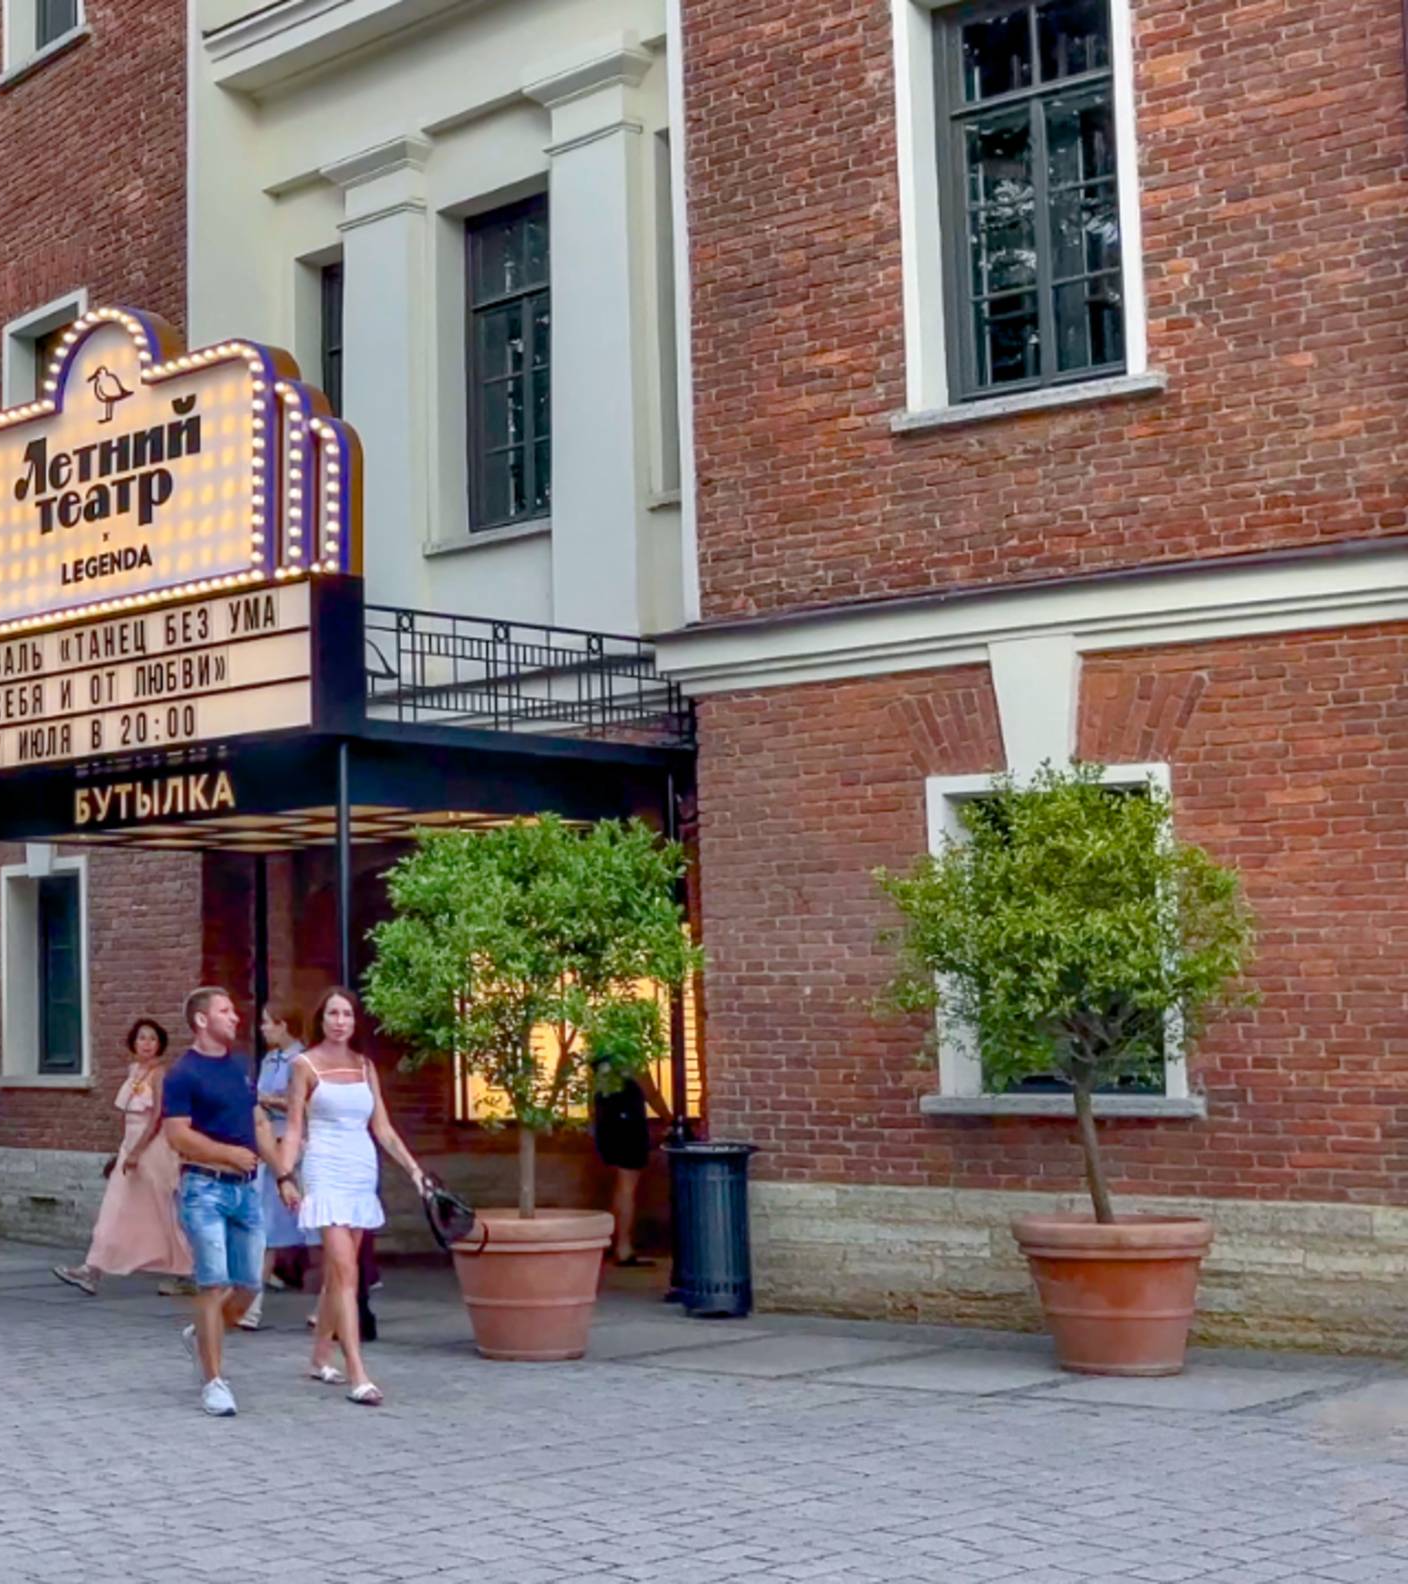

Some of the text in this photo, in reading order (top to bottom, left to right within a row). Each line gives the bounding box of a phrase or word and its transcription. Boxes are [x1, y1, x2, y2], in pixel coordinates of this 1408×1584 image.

[14, 394, 201, 501] Летний
[35, 467, 173, 534] театр
[61, 543, 153, 586] LEGENDA
[60, 619, 146, 662] «ТАНЕЦ
[165, 608, 209, 646] БЕЗ
[229, 595, 276, 634] УМА
[60, 679, 72, 710] И
[91, 671, 116, 705] ОТ
[134, 655, 226, 697] ЛЮБВИ»
[19, 724, 72, 761] ИЮЛЯ
[91, 719, 102, 749] В
[121, 705, 195, 745] 20:00
[74, 770, 236, 825] БУТЫЛКА
